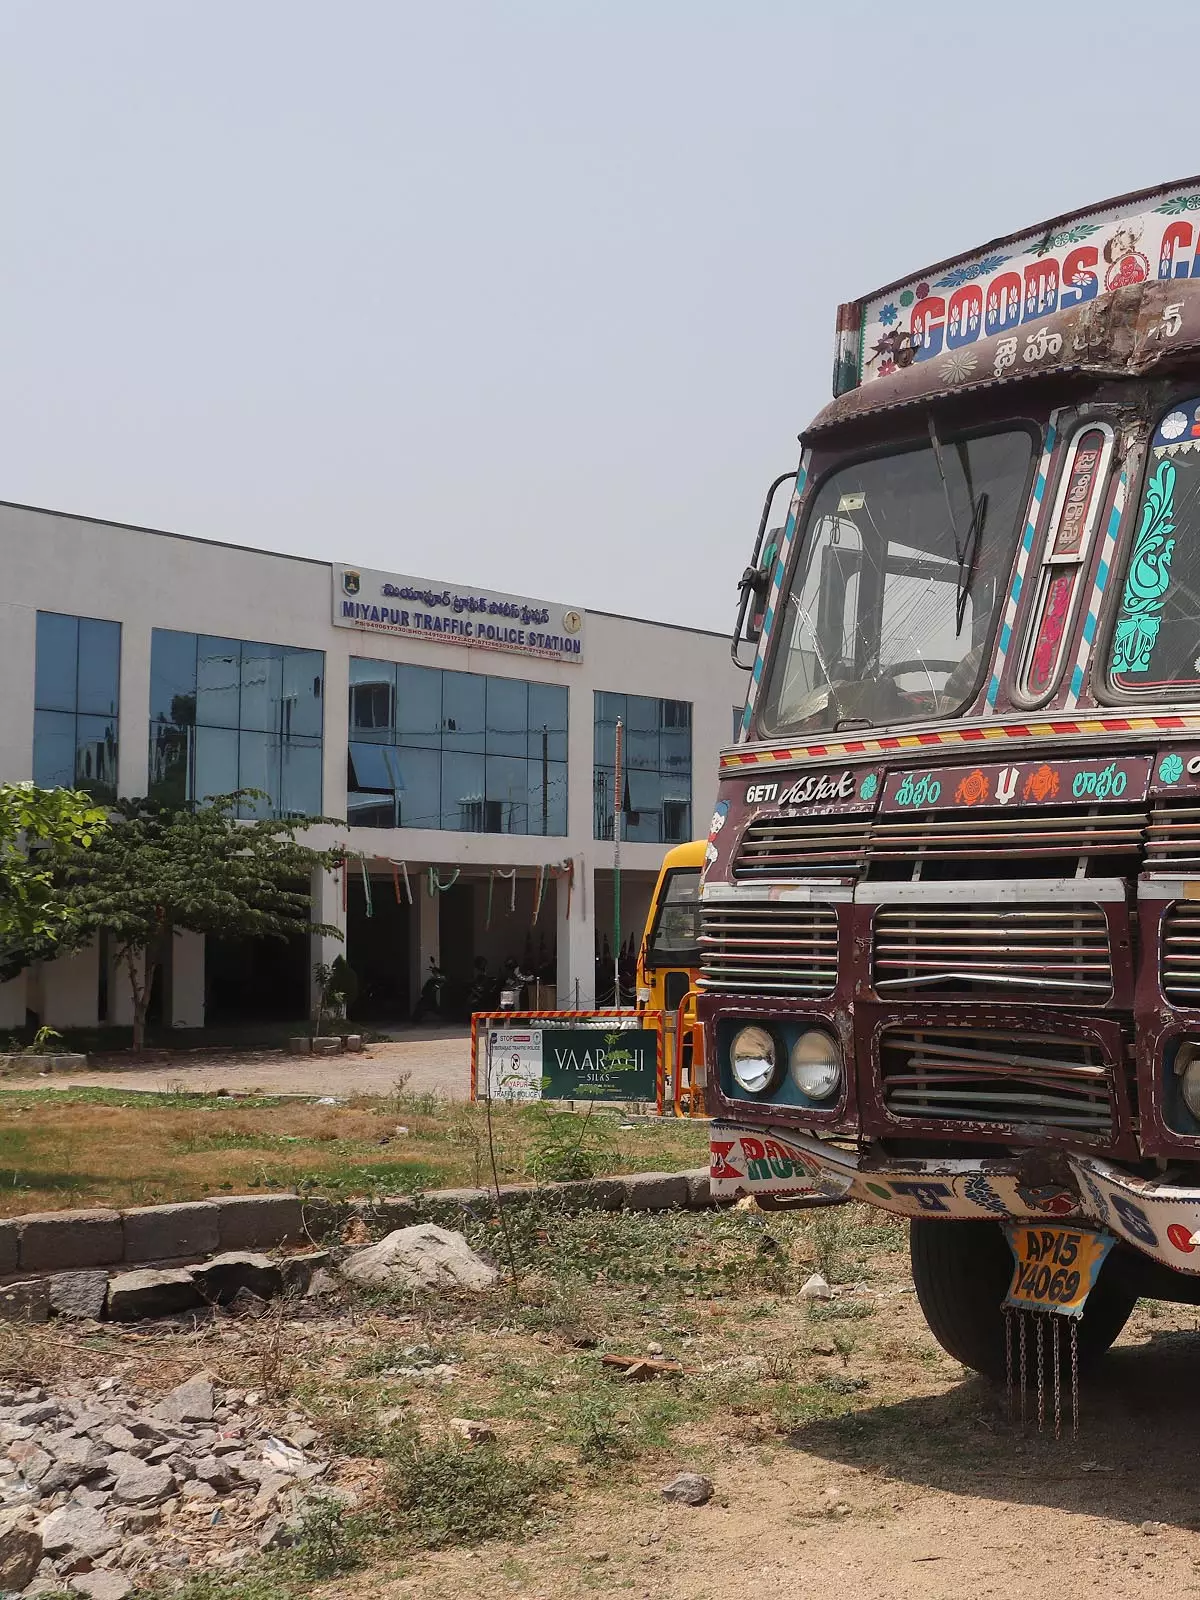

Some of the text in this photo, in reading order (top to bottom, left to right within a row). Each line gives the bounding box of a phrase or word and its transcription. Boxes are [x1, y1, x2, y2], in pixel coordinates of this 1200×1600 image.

[910, 245, 1100, 362] GOODS
[342, 601, 410, 627] MIYAPUR
[414, 612, 473, 637] TRAFFIC
[477, 623, 525, 645] POLICE
[528, 632, 581, 654] STATION
[586, 1073, 610, 1082] SILKS
[1026, 1229, 1082, 1266] AP15
[1015, 1261, 1081, 1303] Y4069
